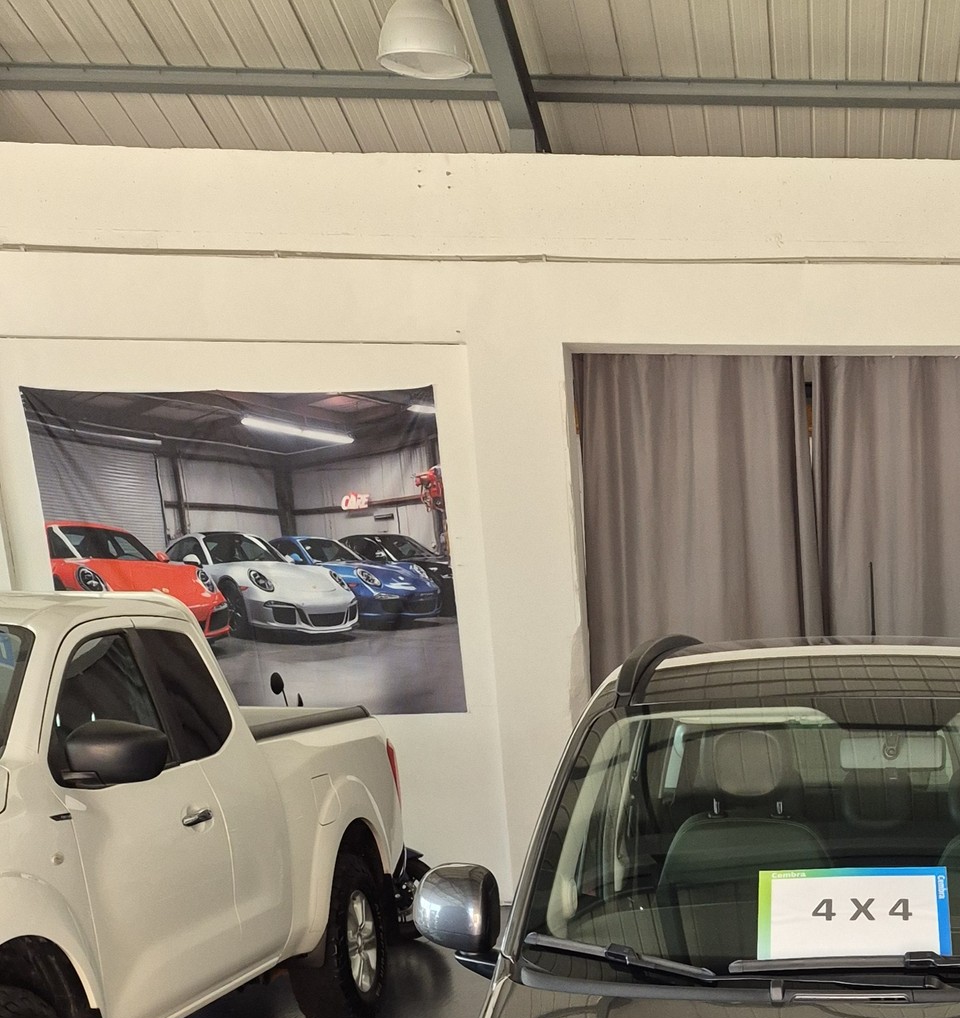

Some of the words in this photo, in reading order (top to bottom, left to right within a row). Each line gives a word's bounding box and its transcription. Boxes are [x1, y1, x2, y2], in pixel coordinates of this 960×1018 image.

[811, 898, 836, 921] 4
[849, 898, 875, 921] X
[888, 898, 913, 921] 4
